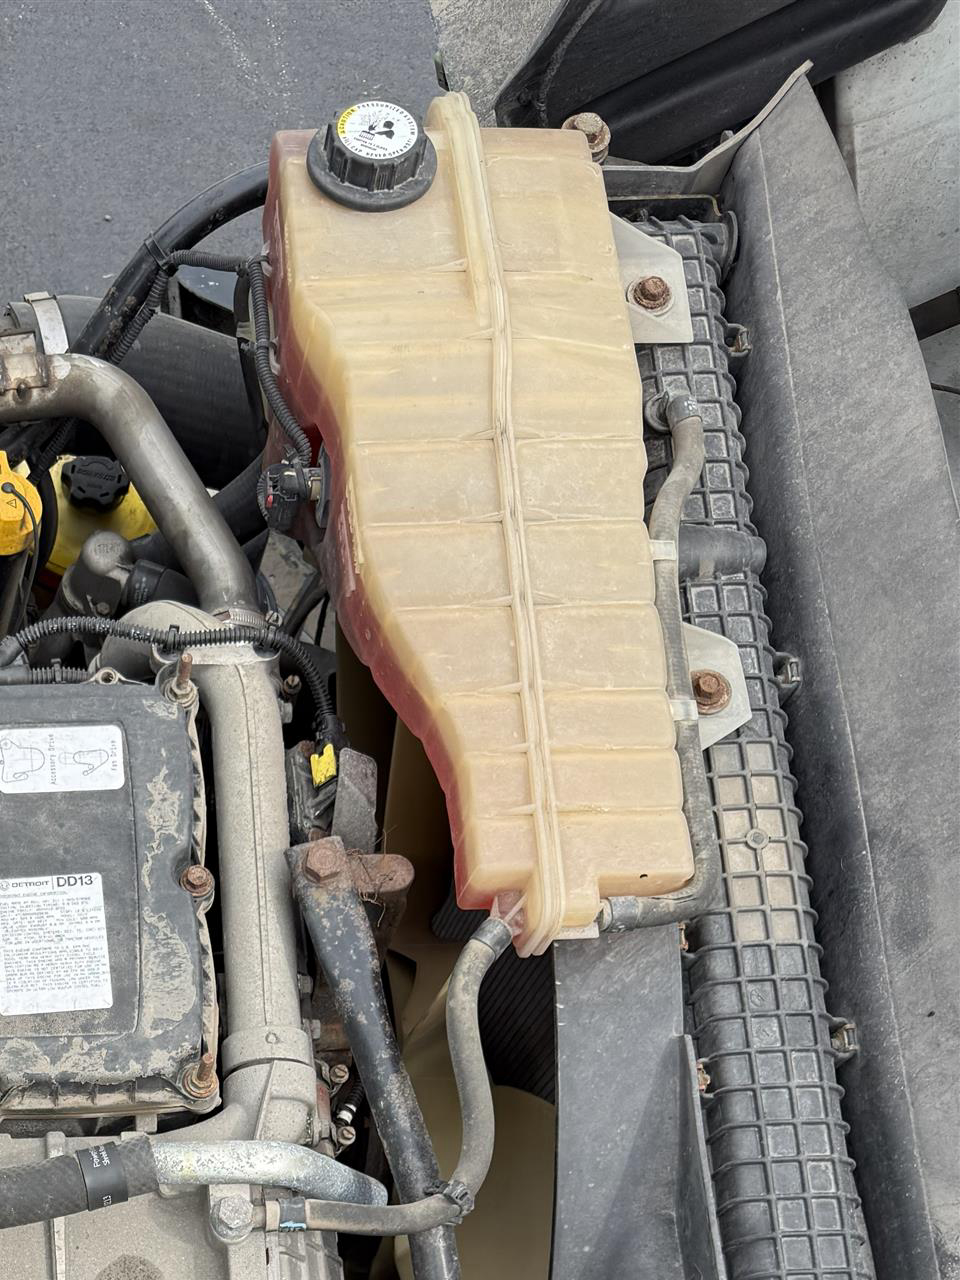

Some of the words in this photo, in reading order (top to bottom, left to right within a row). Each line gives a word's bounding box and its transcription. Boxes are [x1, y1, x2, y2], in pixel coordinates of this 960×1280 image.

[48, 734, 56, 752] Drive
[49, 754, 57, 785] Accessory
[11, 880, 50, 888] DETROIT
[56, 875, 93, 888] DD13
